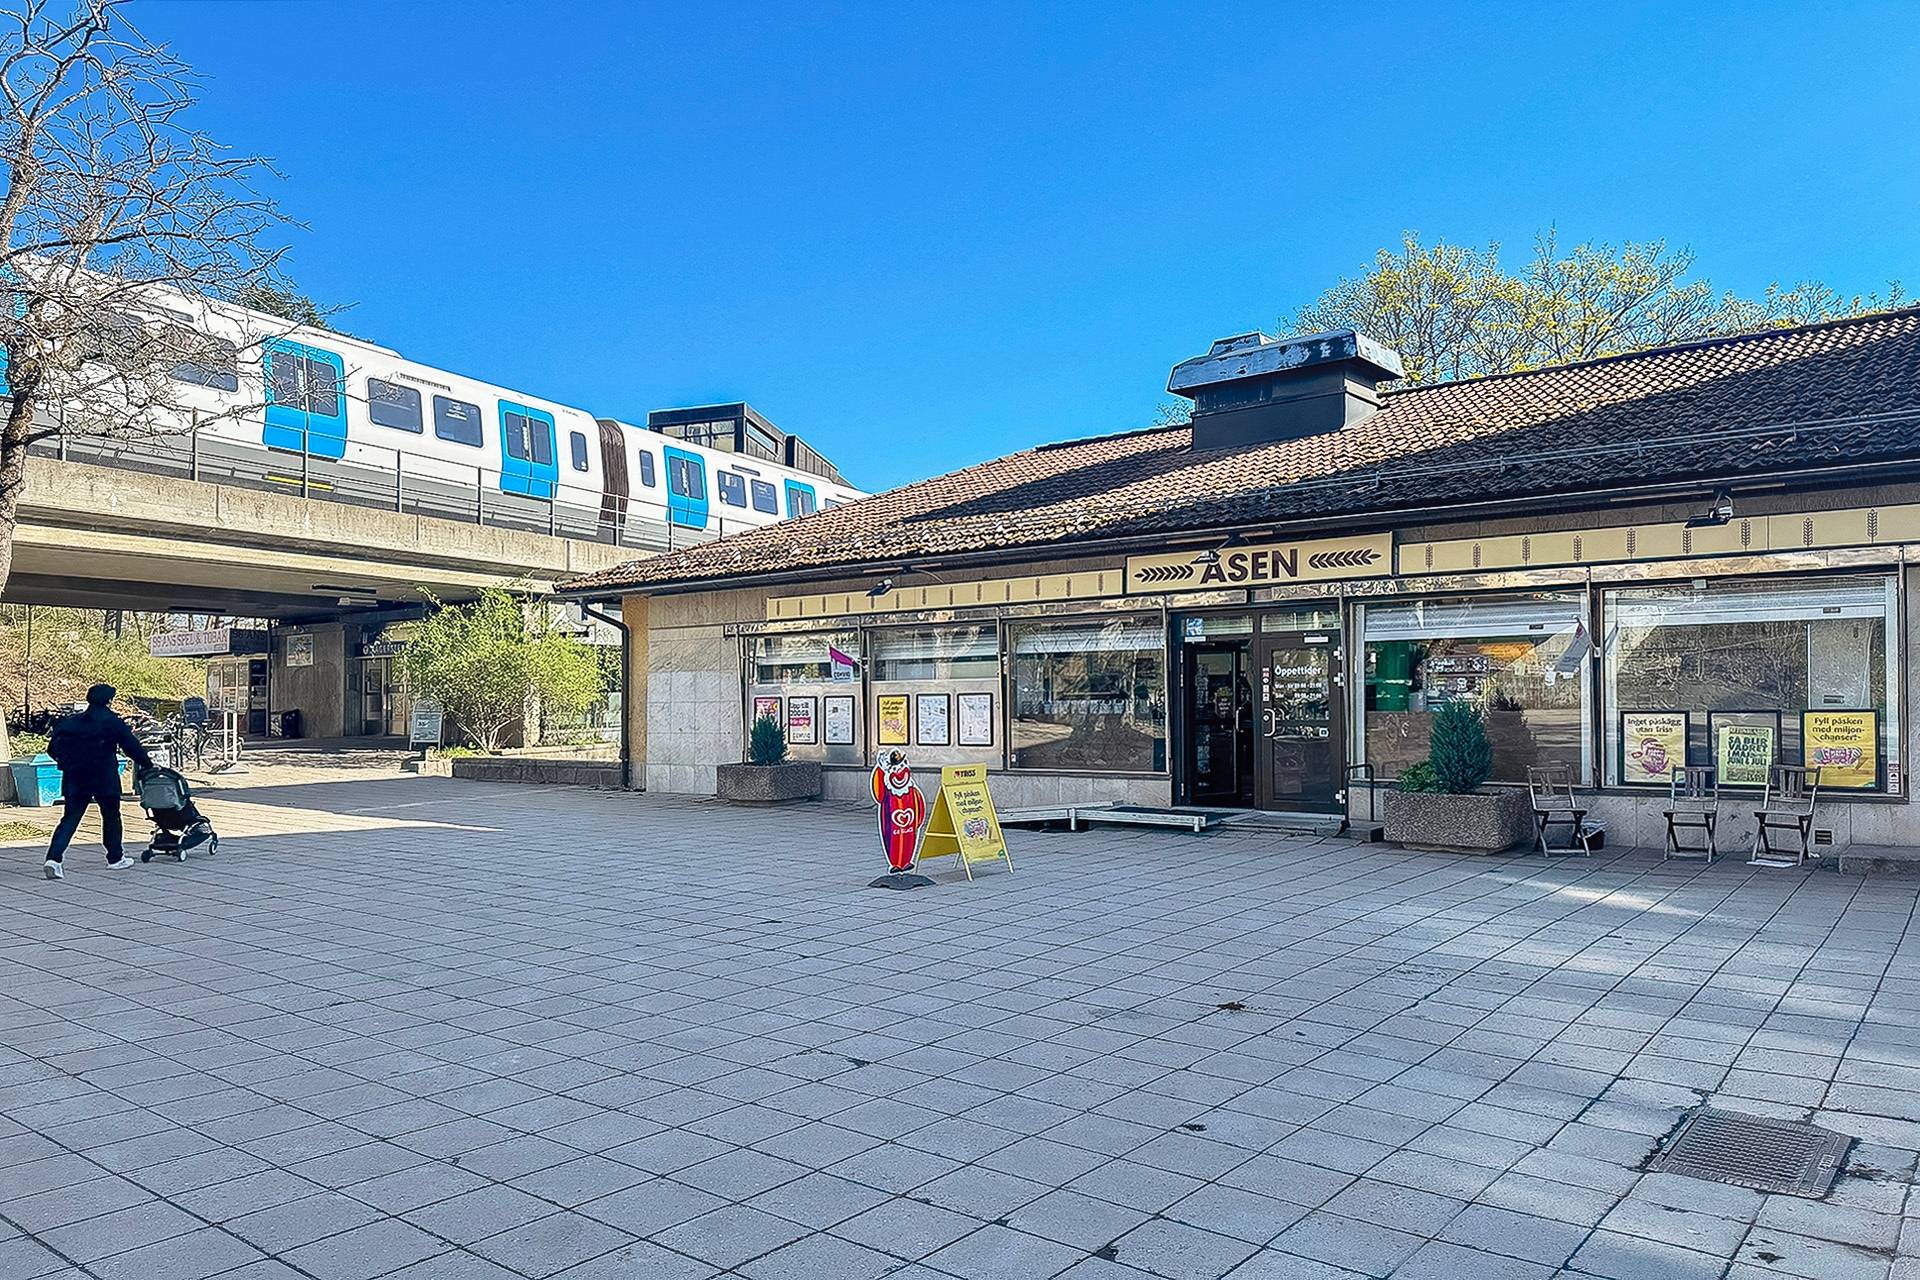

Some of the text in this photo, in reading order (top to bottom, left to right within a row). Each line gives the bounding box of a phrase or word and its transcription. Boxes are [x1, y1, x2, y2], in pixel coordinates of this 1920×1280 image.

[1274, 665, 1322, 676] Öppettider
[1627, 718, 1648, 727] Inget
[1814, 717, 1863, 726] Fyll påsken
[1834, 726, 1865, 734] miljon-
[960, 769, 976, 778] TRISS
